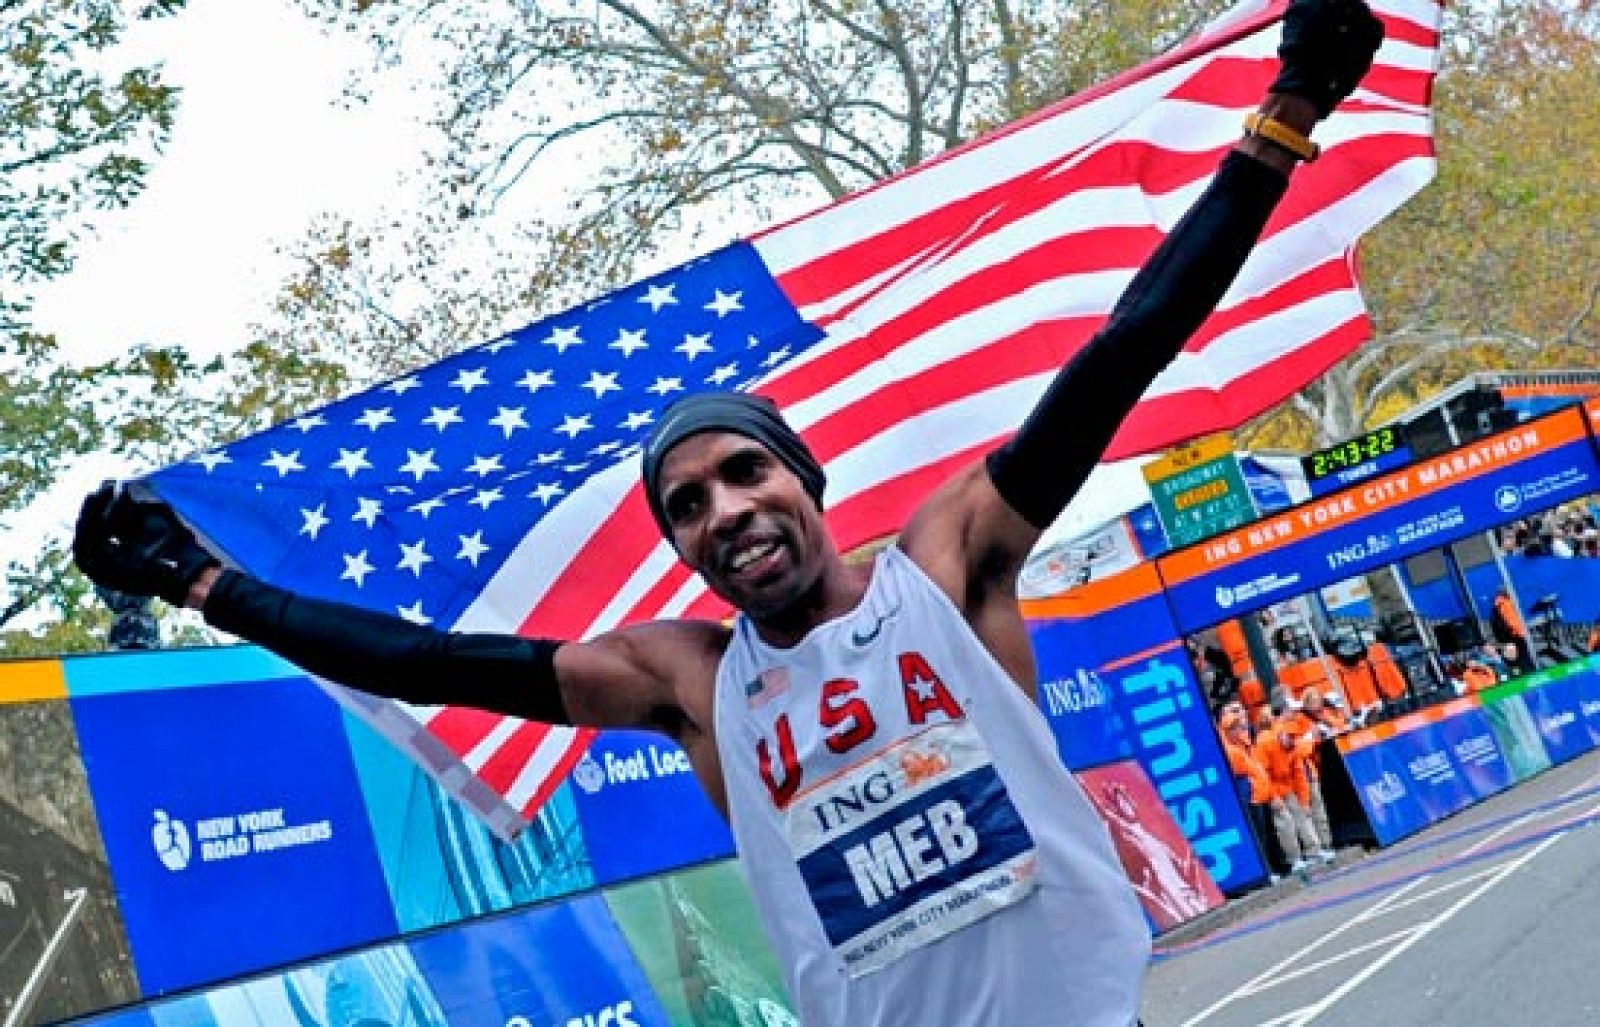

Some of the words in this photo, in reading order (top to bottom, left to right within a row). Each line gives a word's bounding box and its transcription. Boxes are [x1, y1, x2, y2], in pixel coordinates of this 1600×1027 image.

[1205, 537, 1242, 563] ING
[1248, 520, 1293, 548] NEW
[1301, 496, 1357, 528] YORK
[1364, 477, 1409, 504] CITY
[1418, 430, 1539, 486] MARATHON
[1043, 679, 1082, 716] ING
[756, 650, 965, 811] USA
[604, 748, 650, 786] Foot
[1121, 658, 1244, 886] finish
[197, 816, 236, 840] NEW
[237, 806, 286, 833] YORK
[811, 770, 896, 832] ING
[201, 836, 250, 862] ROAD
[252, 819, 333, 853] RUNNERS
[842, 799, 980, 909] MEB
[918, 904, 944, 926] CITY
